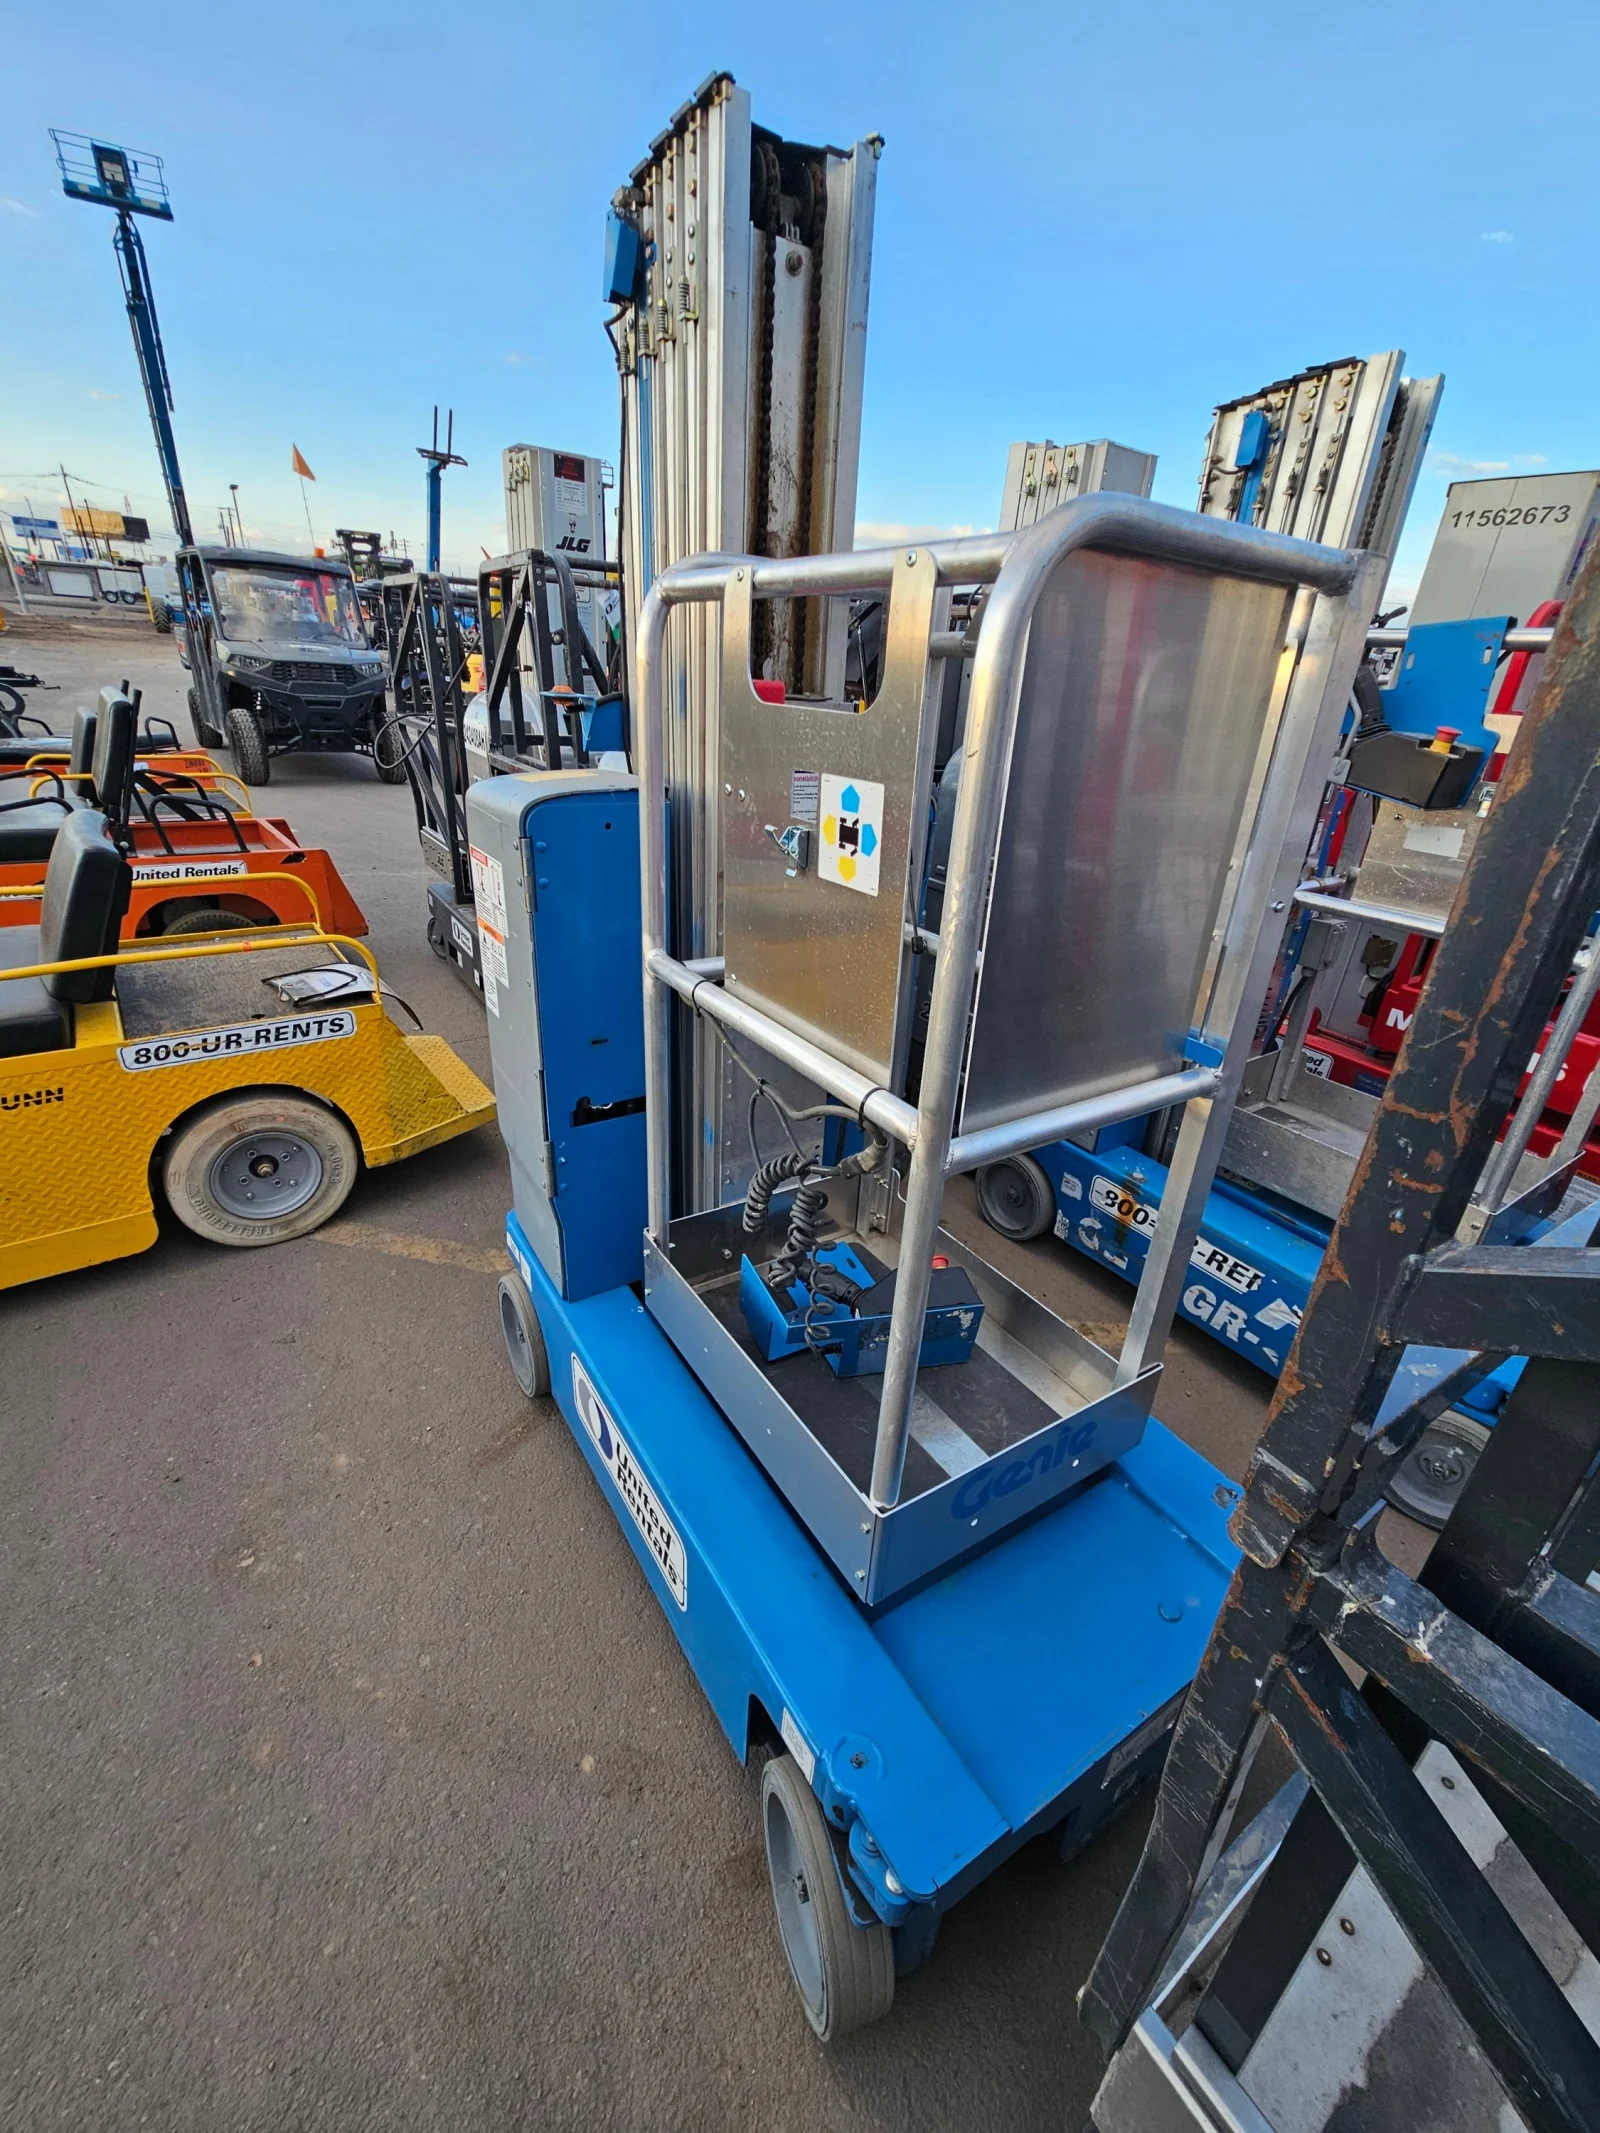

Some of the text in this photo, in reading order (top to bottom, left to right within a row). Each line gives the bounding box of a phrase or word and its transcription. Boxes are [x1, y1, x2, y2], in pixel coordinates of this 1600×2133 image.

[1452, 504, 1571, 528] 11562673
[556, 536, 591, 553] JLG
[132, 864, 239, 880] United Rentals
[133, 1017, 345, 1065] 800-UR-RENTS
[1, 1087, 64, 1111] UNN
[951, 1421, 1099, 1520] Genie
[615, 1441, 673, 1550] United
[615, 1464, 679, 1586] Rentals
